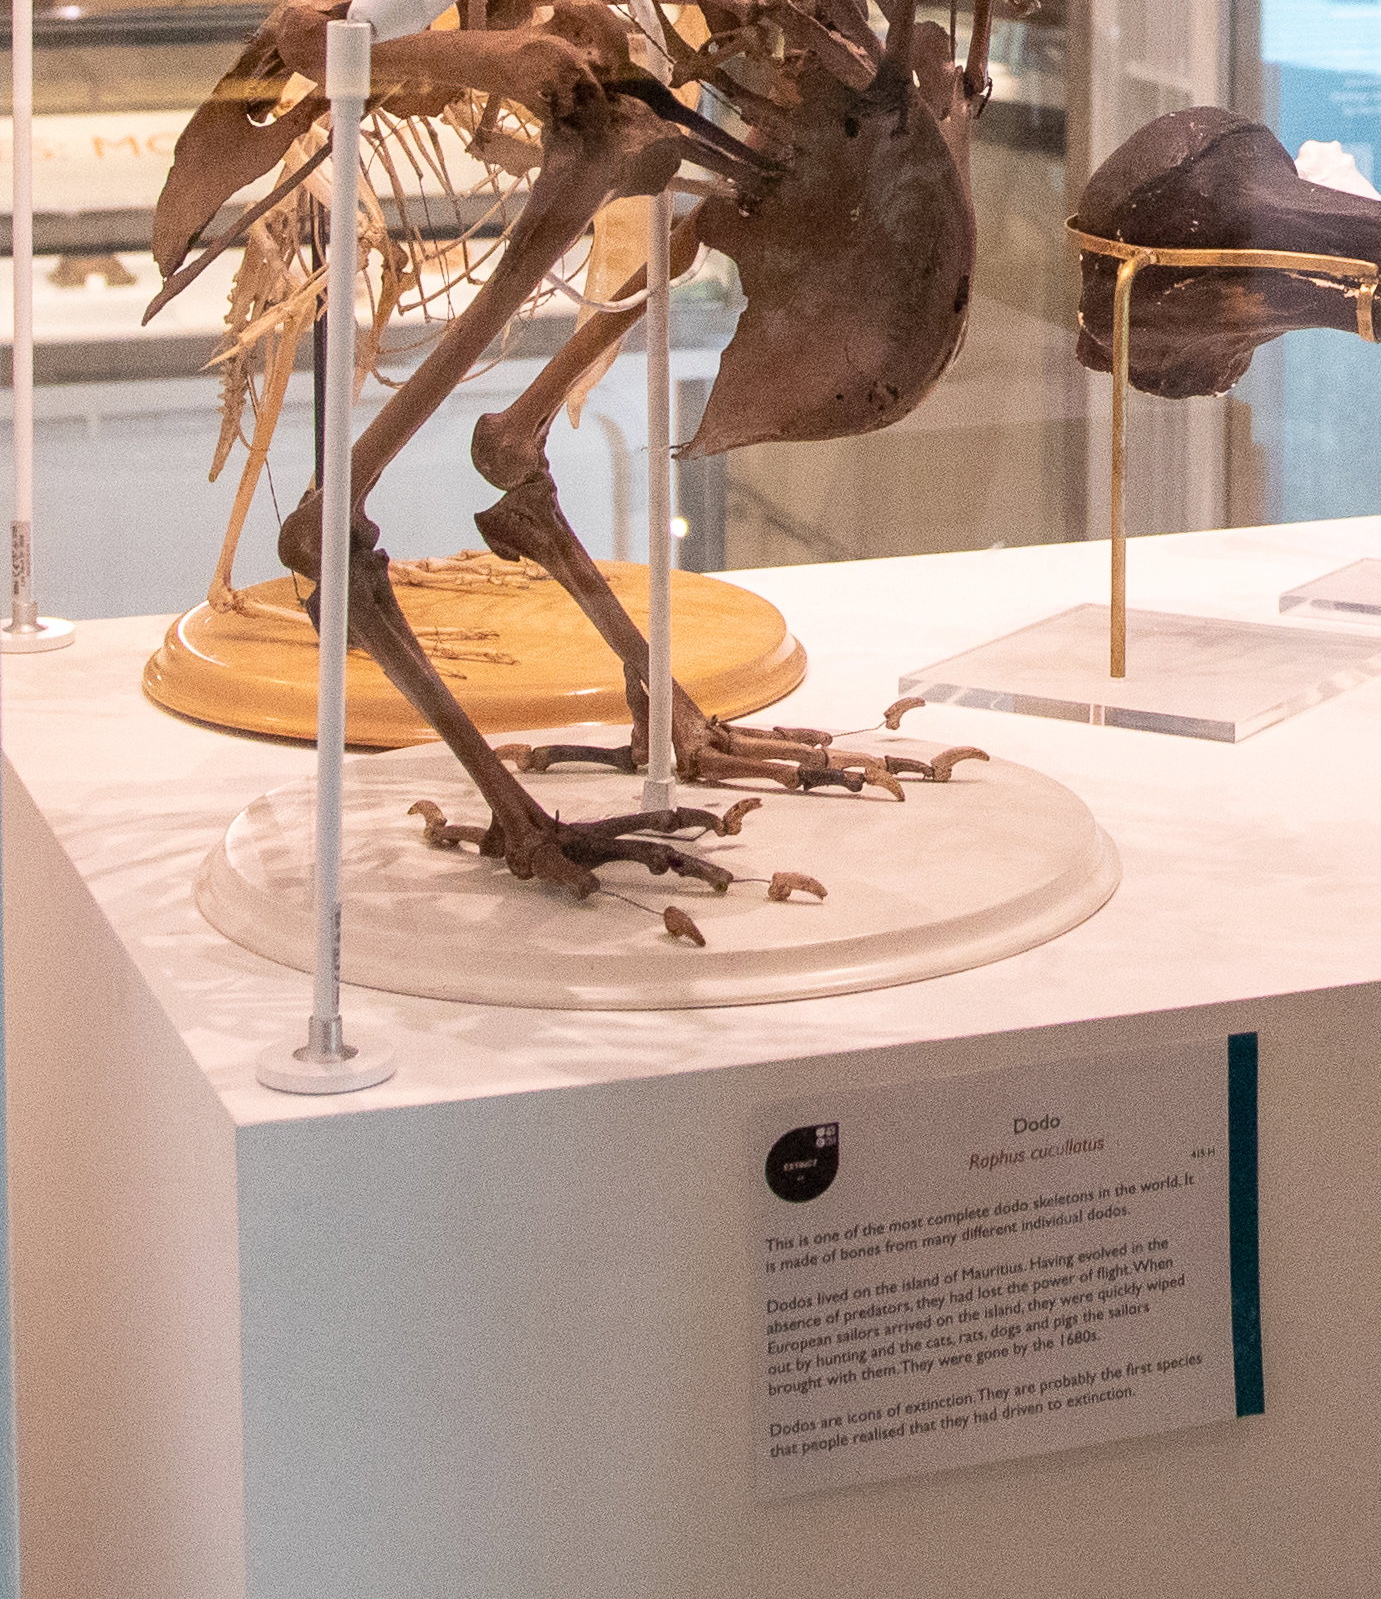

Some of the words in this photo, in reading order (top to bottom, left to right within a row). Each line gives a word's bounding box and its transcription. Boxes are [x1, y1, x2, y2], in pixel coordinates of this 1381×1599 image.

[1013, 1114, 1060, 1134] Dodo
[764, 1238, 794, 1252] This
[798, 1235, 809, 1247] is
[812, 1232, 840, 1245] one
[844, 1224, 859, 1240] of
[862, 1223, 885, 1237] the
[888, 1218, 923, 1232] most
[926, 1207, 990, 1226] complete
[994, 1200, 1029, 1215] dodo
[1032, 1192, 1094, 1210] skeletons
[1098, 1189, 1110, 1198] in
[1114, 1184, 1136, 1197] the
[1184, 1173, 1194, 1185] It
[766, 1296, 813, 1314] Dodos
[816, 1288, 849, 1305] lived
[852, 1288, 871, 1299] on
[874, 1282, 897, 1296] the
[902, 1274, 939, 1291] island
[942, 1270, 958, 1284] of
[1028, 1255, 1074, 1270] Having
[1076, 1243, 1127, 1263] evolved
[1132, 1244, 1143, 1254] in
[1146, 1238, 1169, 1251] the
[766, 1336, 832, 1355] European
[836, 1328, 880, 1343] sailors
[884, 1315, 932, 1335] arrived
[936, 1315, 953, 1327] on
[958, 1309, 980, 1323] the
[1028, 1298, 1056, 1312] they
[1060, 1293, 1093, 1305] were
[1098, 1282, 1142, 1303] quickly
[1146, 1273, 1185, 1293] wiped
[768, 1377, 822, 1397] brought
[826, 1370, 857, 1385] with
[900, 1359, 934, 1373] They
[938, 1354, 972, 1366] were
[976, 1348, 1009, 1365] gone
[1012, 1343, 1028, 1357] by
[1032, 1338, 1054, 1352] the
[768, 1420, 816, 1437] Dodos
[820, 1416, 842, 1429] are
[846, 1409, 882, 1424] icons
[886, 1403, 901, 1418] of
[974, 1387, 1010, 1402] They
[1014, 1383, 1036, 1396] are
[1040, 1371, 1097, 1395] probably
[1100, 1367, 1122, 1381] the
[1126, 1362, 1153, 1376] first
[1156, 1355, 1203, 1374] species
[770, 1444, 798, 1458] that
[802, 1434, 848, 1455] people
[852, 1424, 905, 1444] realised
[908, 1420, 936, 1435] that
[940, 1415, 969, 1430] they
[972, 1407, 998, 1424] had
[1002, 1403, 1043, 1419] driven
[1046, 1400, 1062, 1410] to
